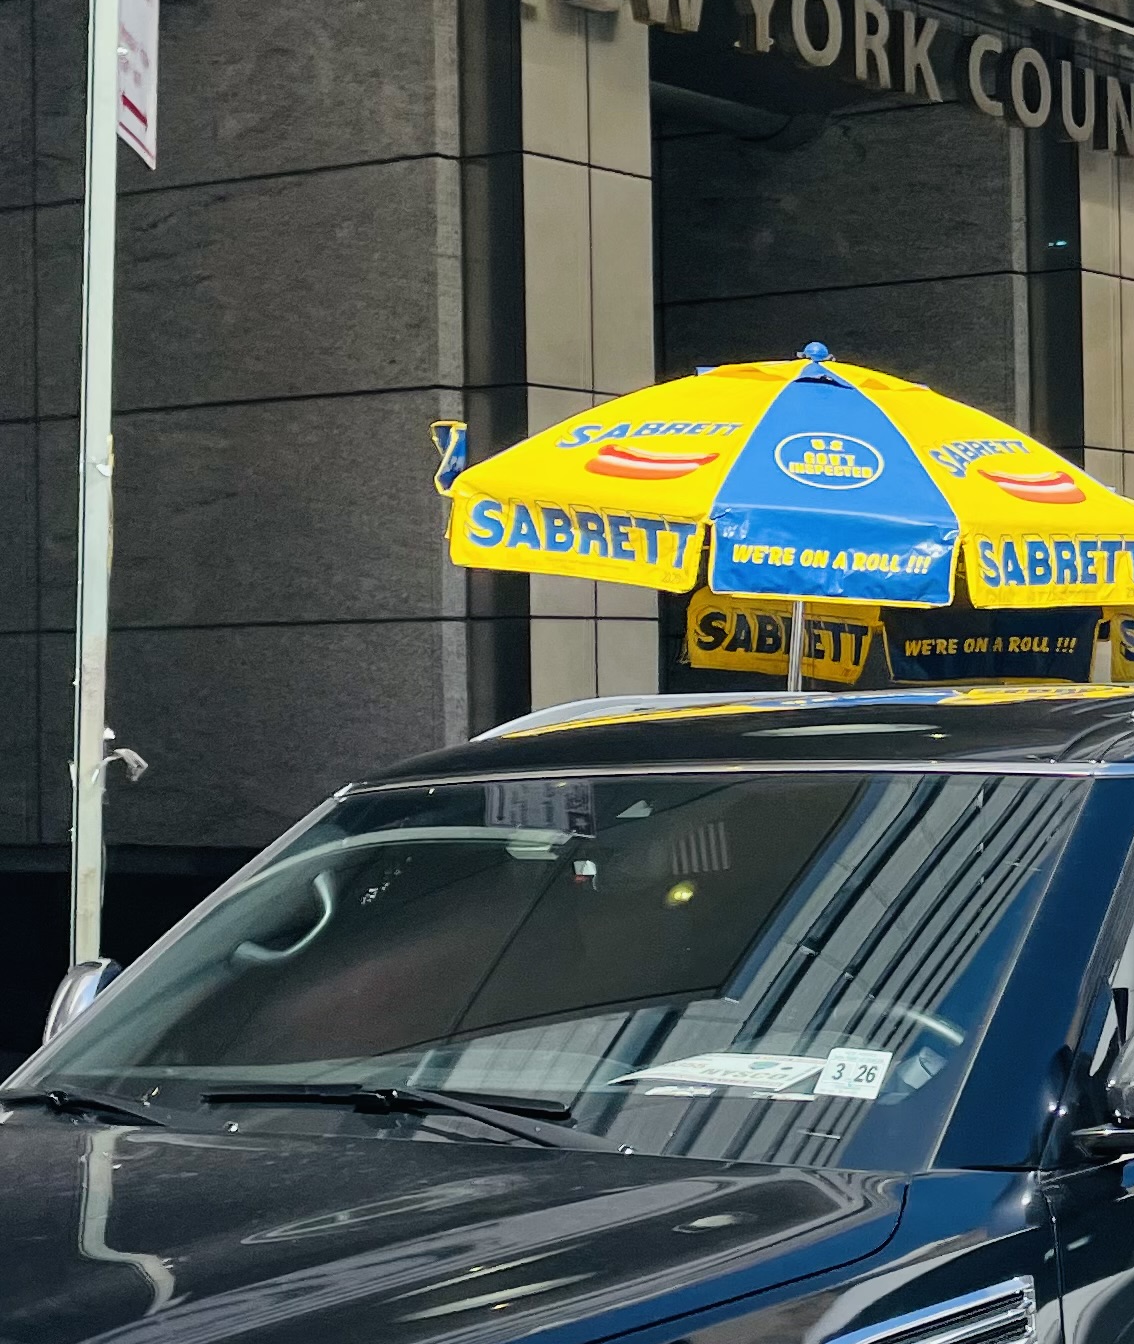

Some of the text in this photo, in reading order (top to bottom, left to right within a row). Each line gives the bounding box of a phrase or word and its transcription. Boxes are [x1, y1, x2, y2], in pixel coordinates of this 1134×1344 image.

[556, 421, 742, 448] SABRETT
[929, 439, 1031, 478] SABRETT
[466, 496, 699, 570] SABRETT
[732, 544, 796, 567] WE'RE
[799, 549, 830, 569] ON
[831, 550, 847, 570] A
[852, 553, 901, 573] ROLL
[904, 638, 959, 656] WE'RE
[963, 637, 990, 654] ON
[992, 636, 1004, 653] A
[1008, 636, 1050, 653] ROLL
[831, 1062, 878, 1084] 3 26
